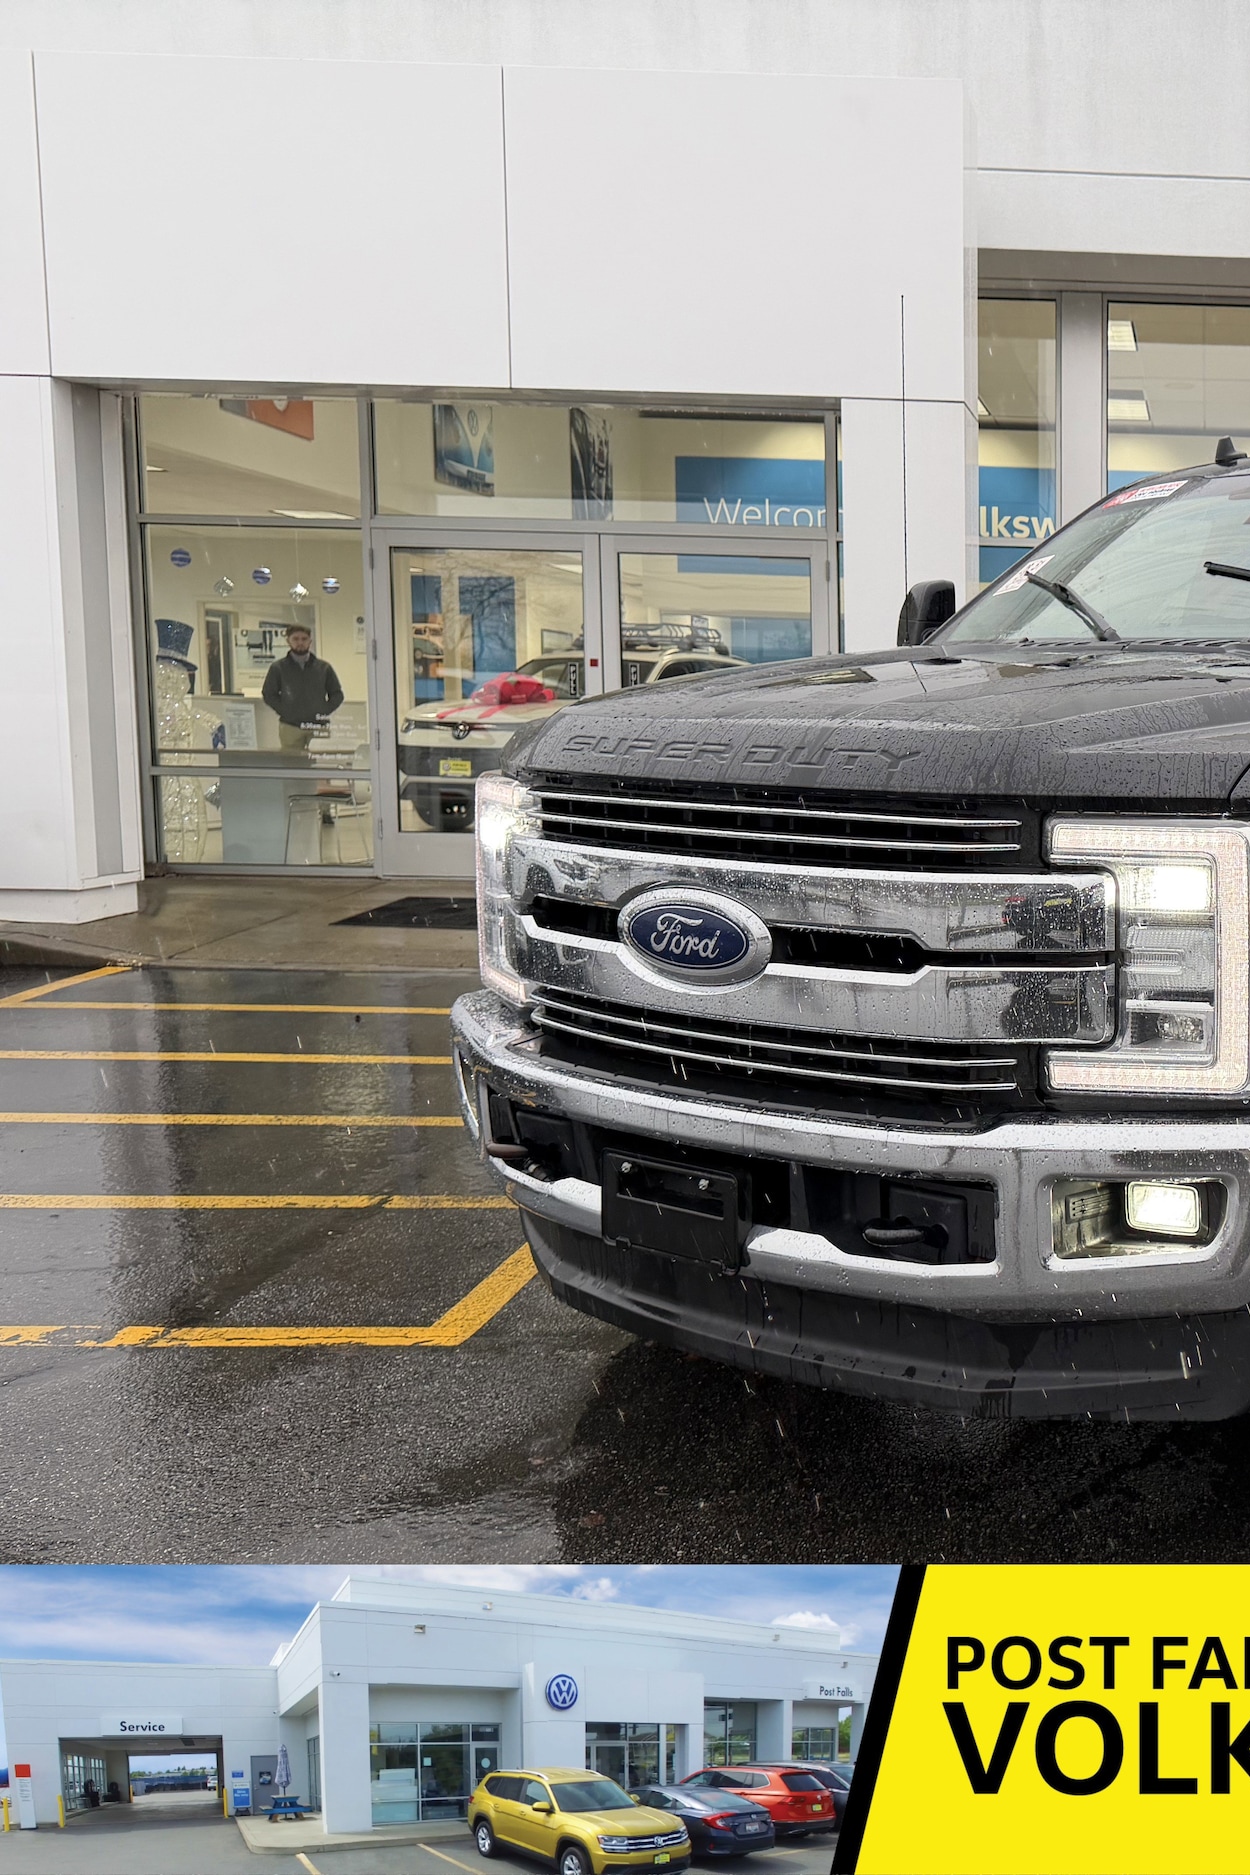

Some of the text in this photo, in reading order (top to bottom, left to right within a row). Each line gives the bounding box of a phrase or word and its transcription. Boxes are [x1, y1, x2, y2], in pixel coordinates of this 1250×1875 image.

[562, 733, 922, 771] SUPER DUTY
[650, 912, 721, 959] Ford
